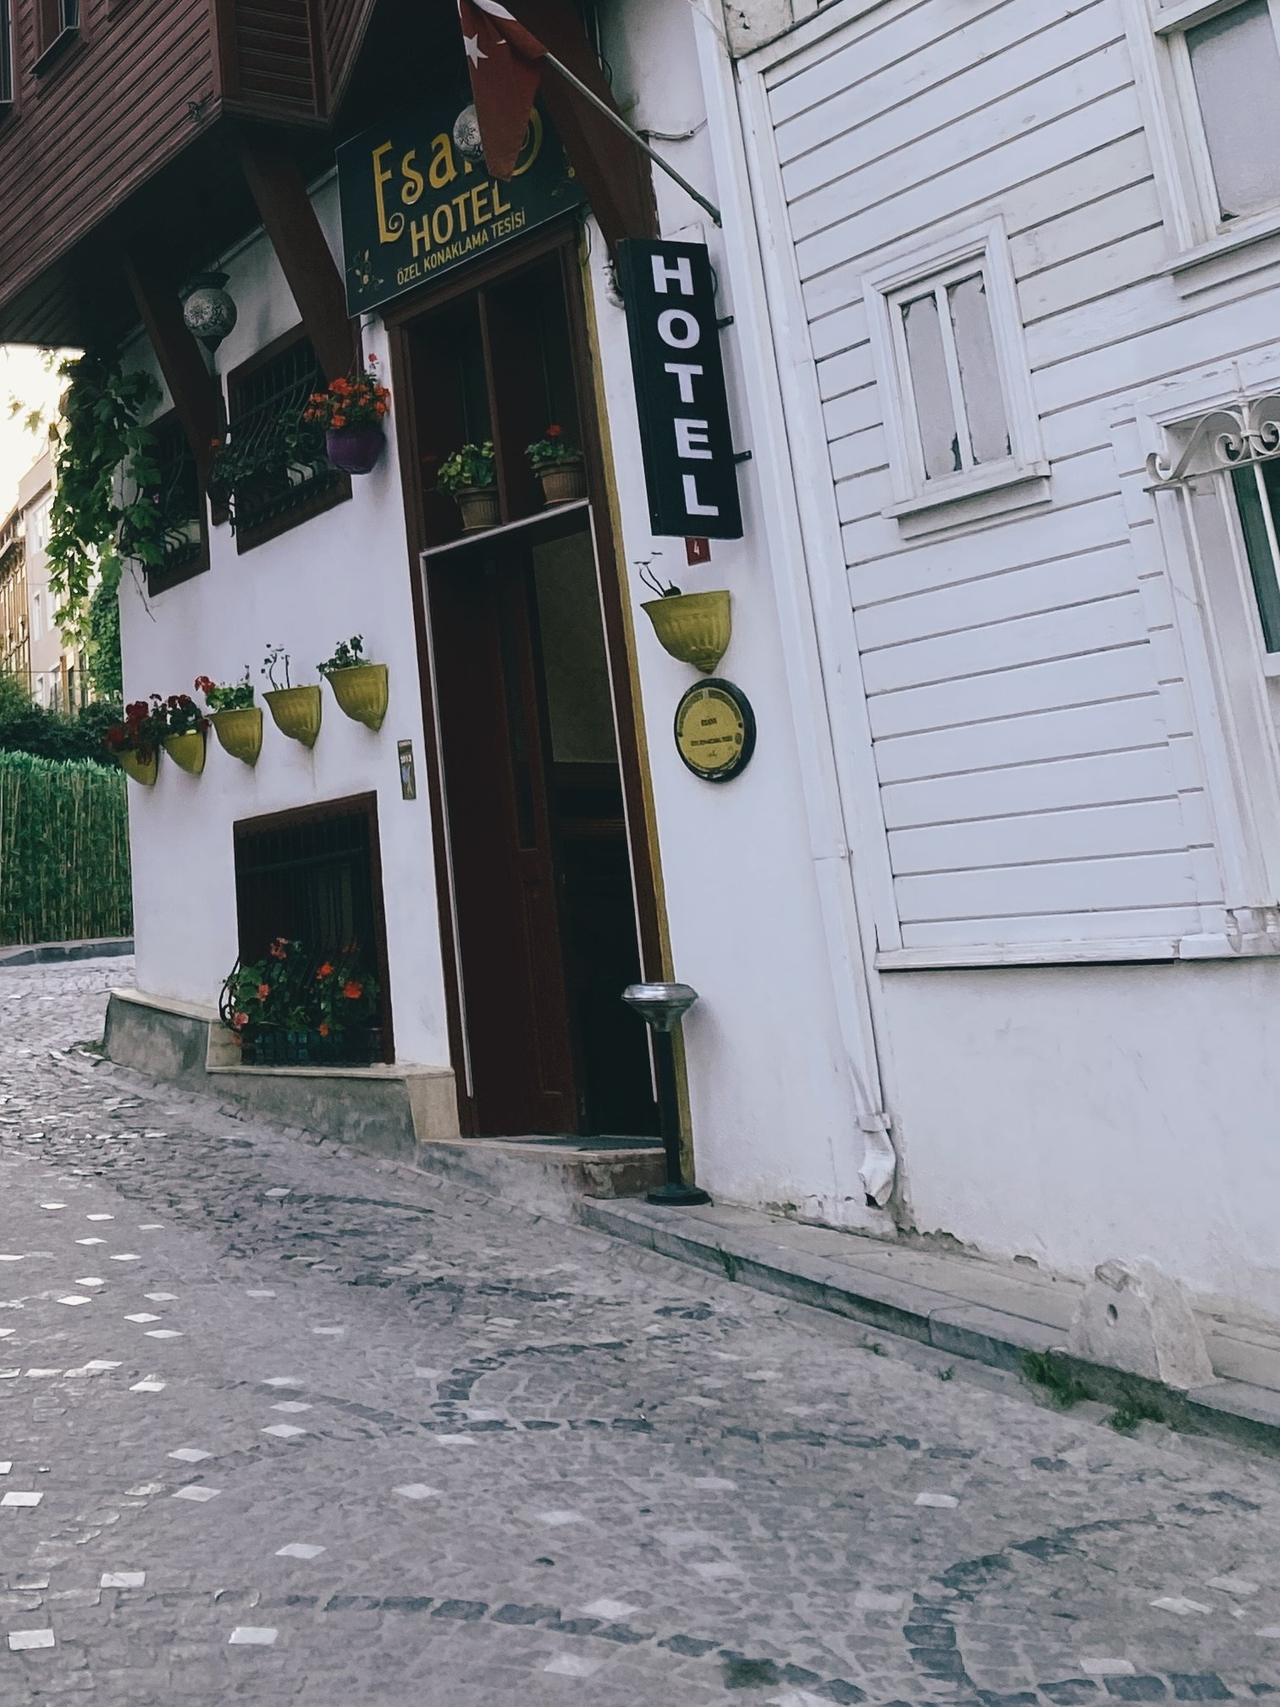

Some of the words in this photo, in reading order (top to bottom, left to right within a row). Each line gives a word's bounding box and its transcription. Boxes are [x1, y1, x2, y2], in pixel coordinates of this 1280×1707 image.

[372, 106, 543, 244] Esa
[410, 180, 511, 257] HOTEL
[397, 263, 422, 285] ÖZEL
[423, 228, 489, 273] KONAKLAMA
[491, 206, 526, 239] TESİSİ
[650, 254, 719, 516] HOTEL
